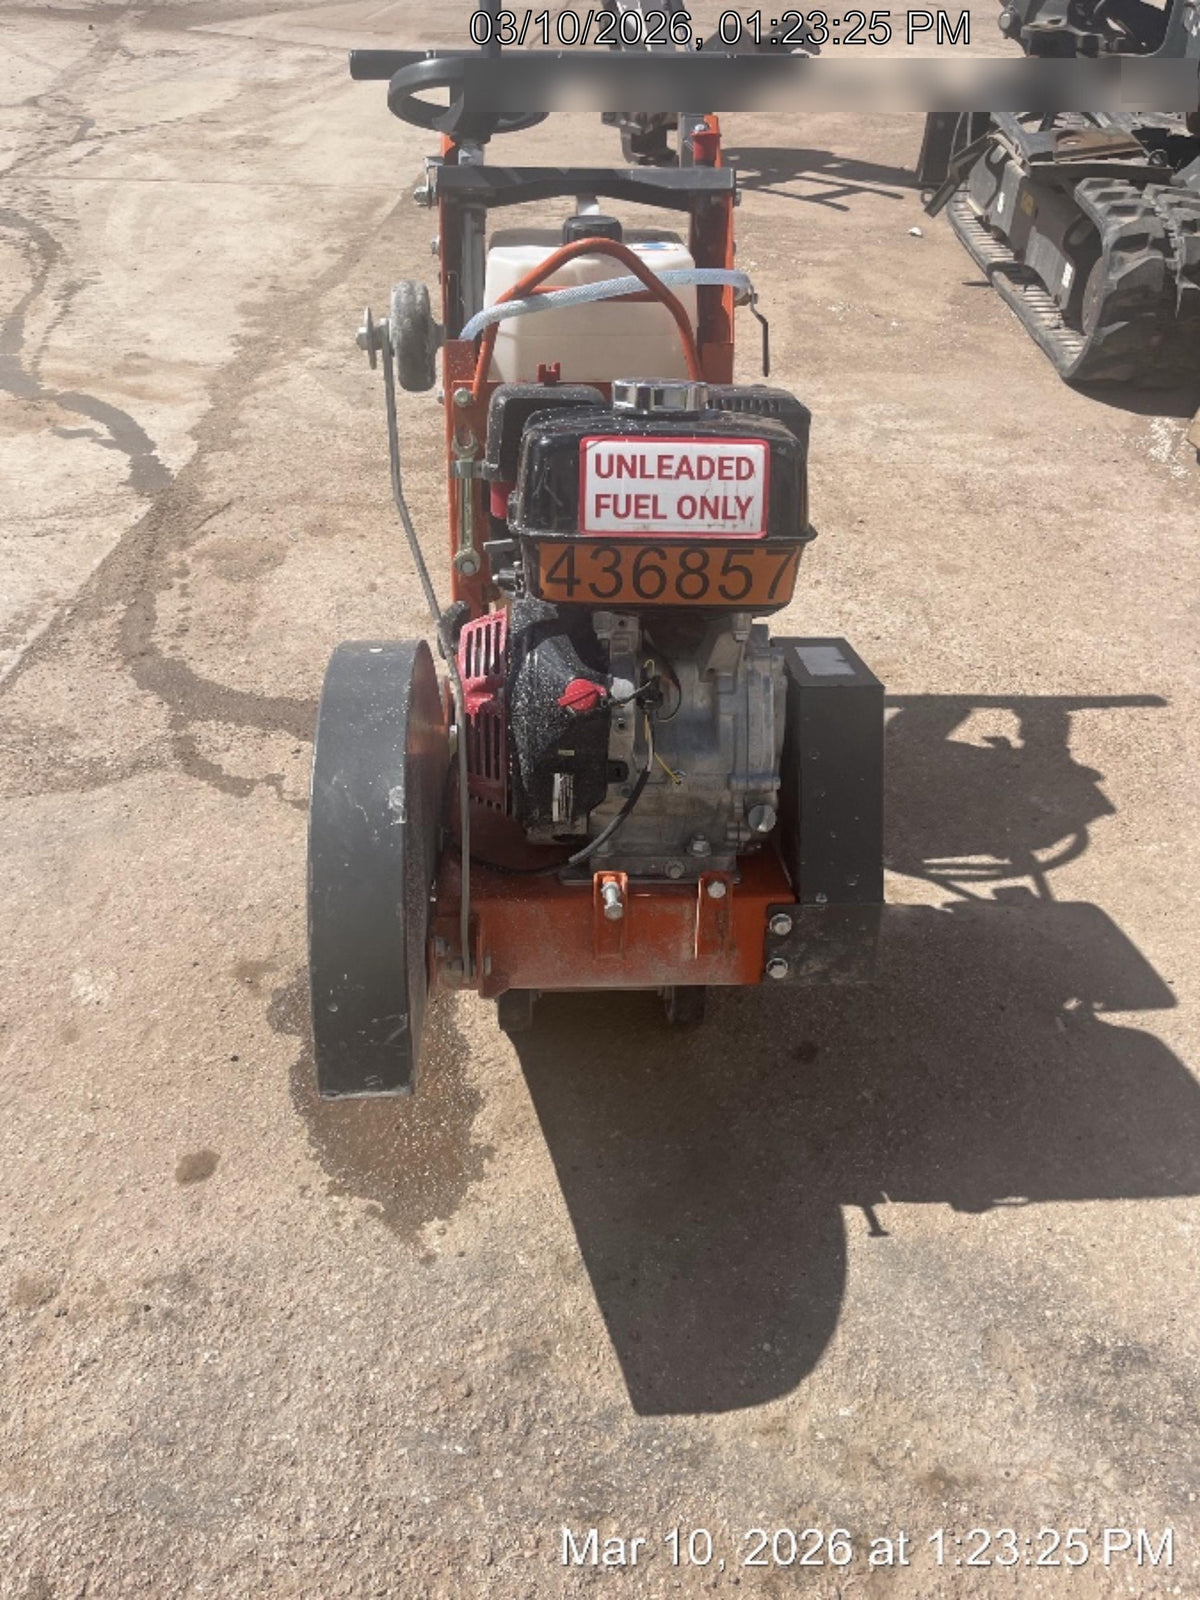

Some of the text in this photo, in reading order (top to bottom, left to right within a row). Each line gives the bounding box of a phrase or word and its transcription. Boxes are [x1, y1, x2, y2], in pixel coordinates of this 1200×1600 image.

[594, 454, 755, 481] UNLEADED
[594, 493, 754, 520] FUEL ONLY
[546, 545, 798, 600] 436857
